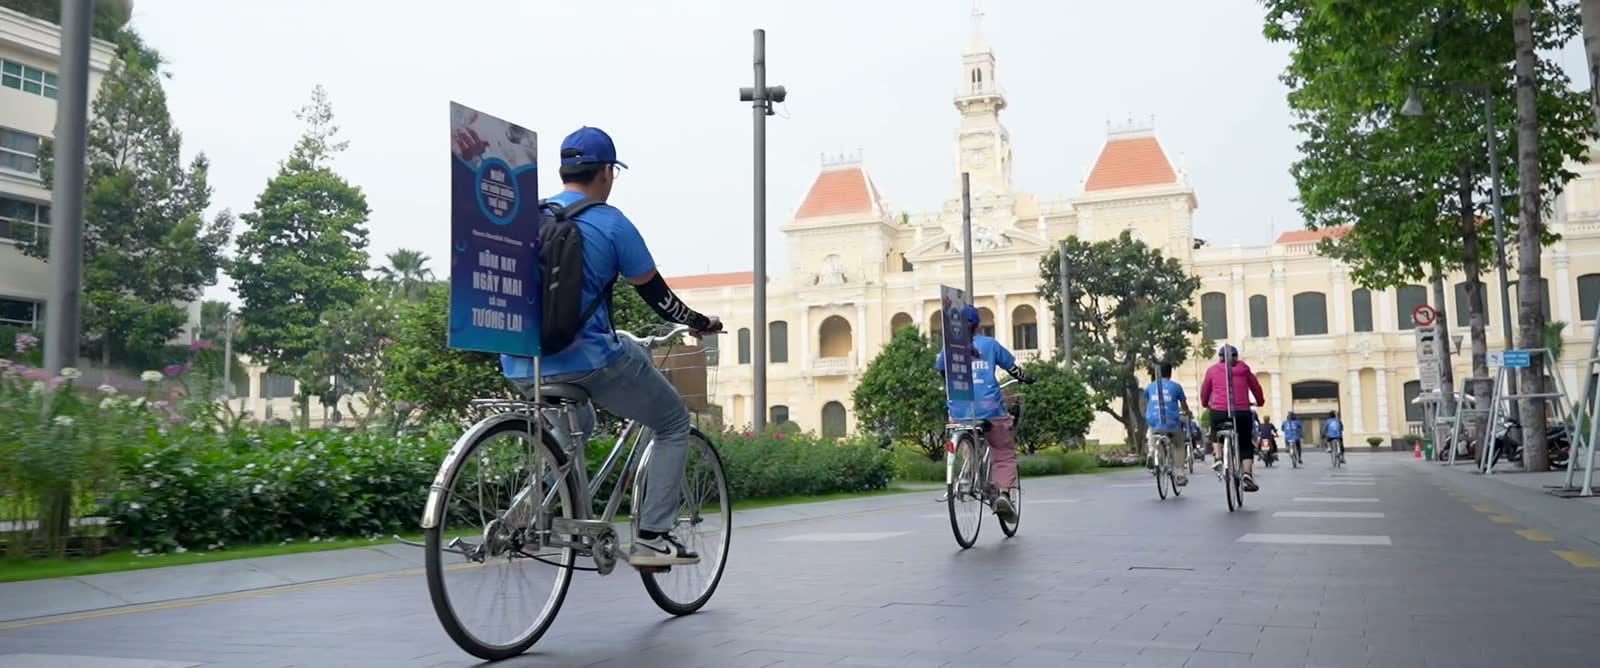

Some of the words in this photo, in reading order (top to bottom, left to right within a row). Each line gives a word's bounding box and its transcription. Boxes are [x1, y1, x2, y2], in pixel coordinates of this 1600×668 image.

[473, 270, 500, 292] NGÀY
[502, 278, 522, 297] MAI
[507, 313, 522, 333] LAI
